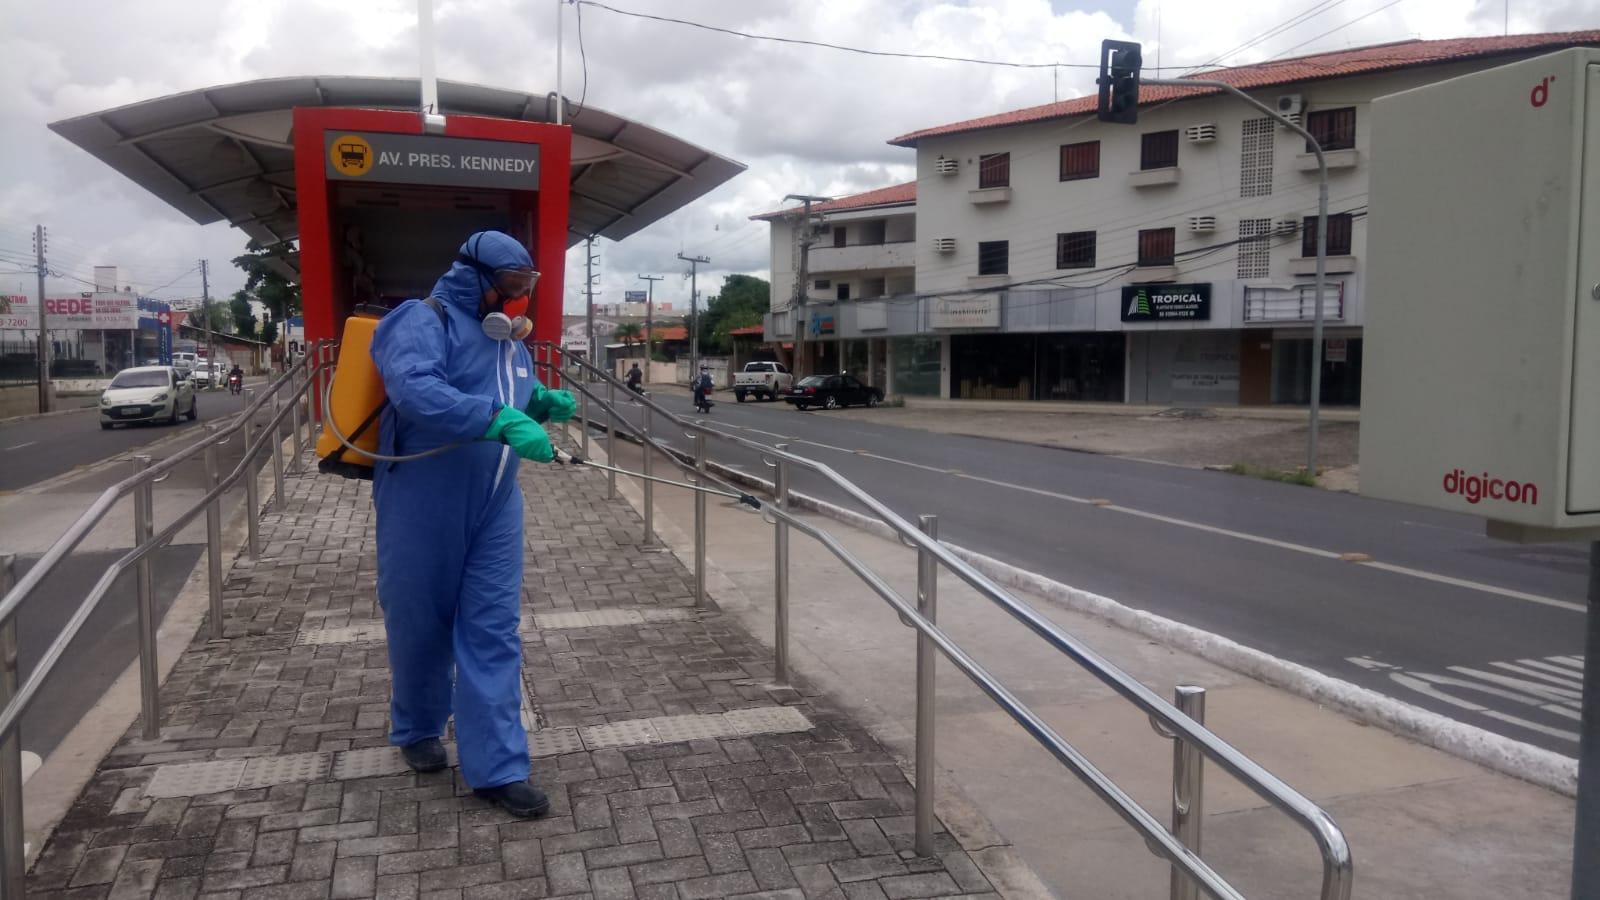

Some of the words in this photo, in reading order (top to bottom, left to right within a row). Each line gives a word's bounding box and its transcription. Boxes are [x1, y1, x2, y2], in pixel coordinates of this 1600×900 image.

[379, 151, 403, 166] AV.
[408, 153, 456, 169] PRES.
[460, 156, 535, 173] KENNEDY
[44, 299, 92, 315] REDE
[1151, 294, 1202, 304] TROPICAL
[1443, 468, 1537, 505] digicon
